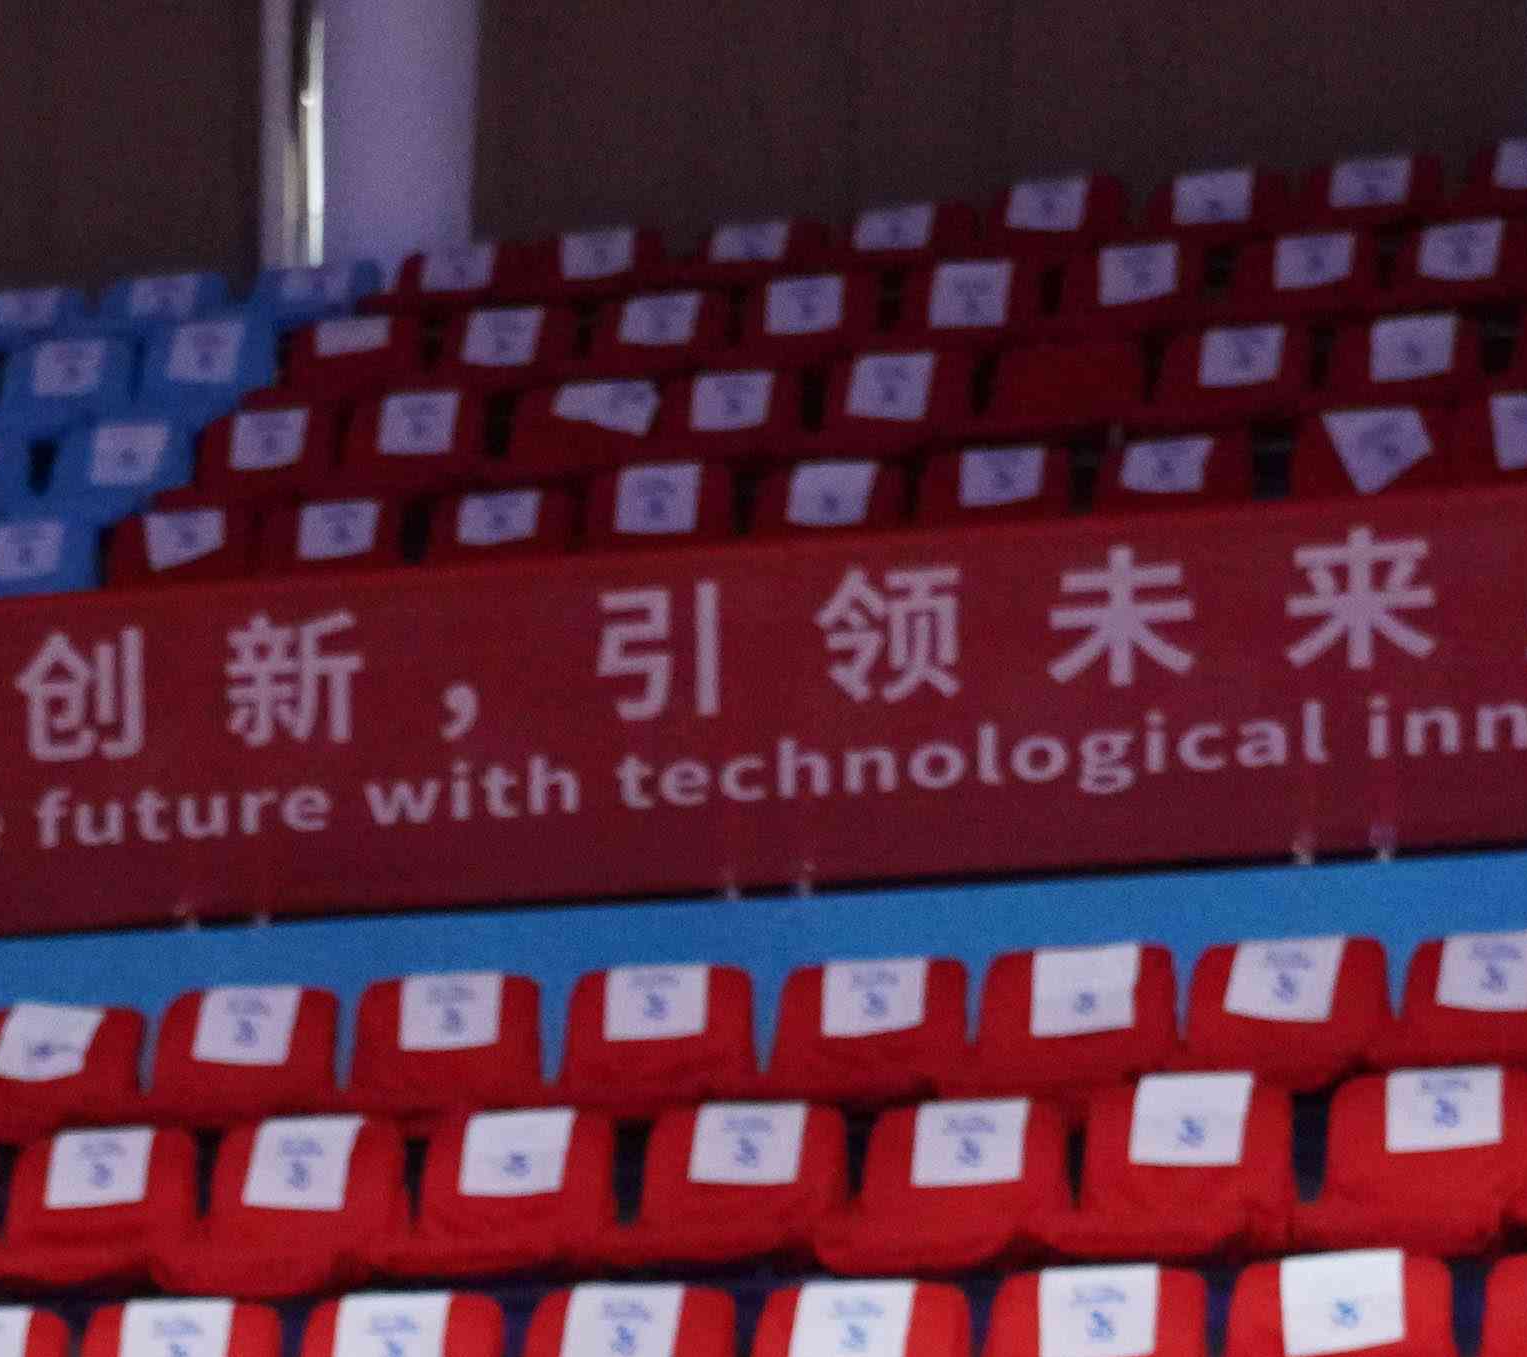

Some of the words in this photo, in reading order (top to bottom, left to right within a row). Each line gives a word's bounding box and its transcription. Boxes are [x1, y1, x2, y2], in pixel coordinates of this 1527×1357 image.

[35, 788, 329, 847] future
[366, 755, 579, 825] with
[616, 701, 1327, 808] technological
